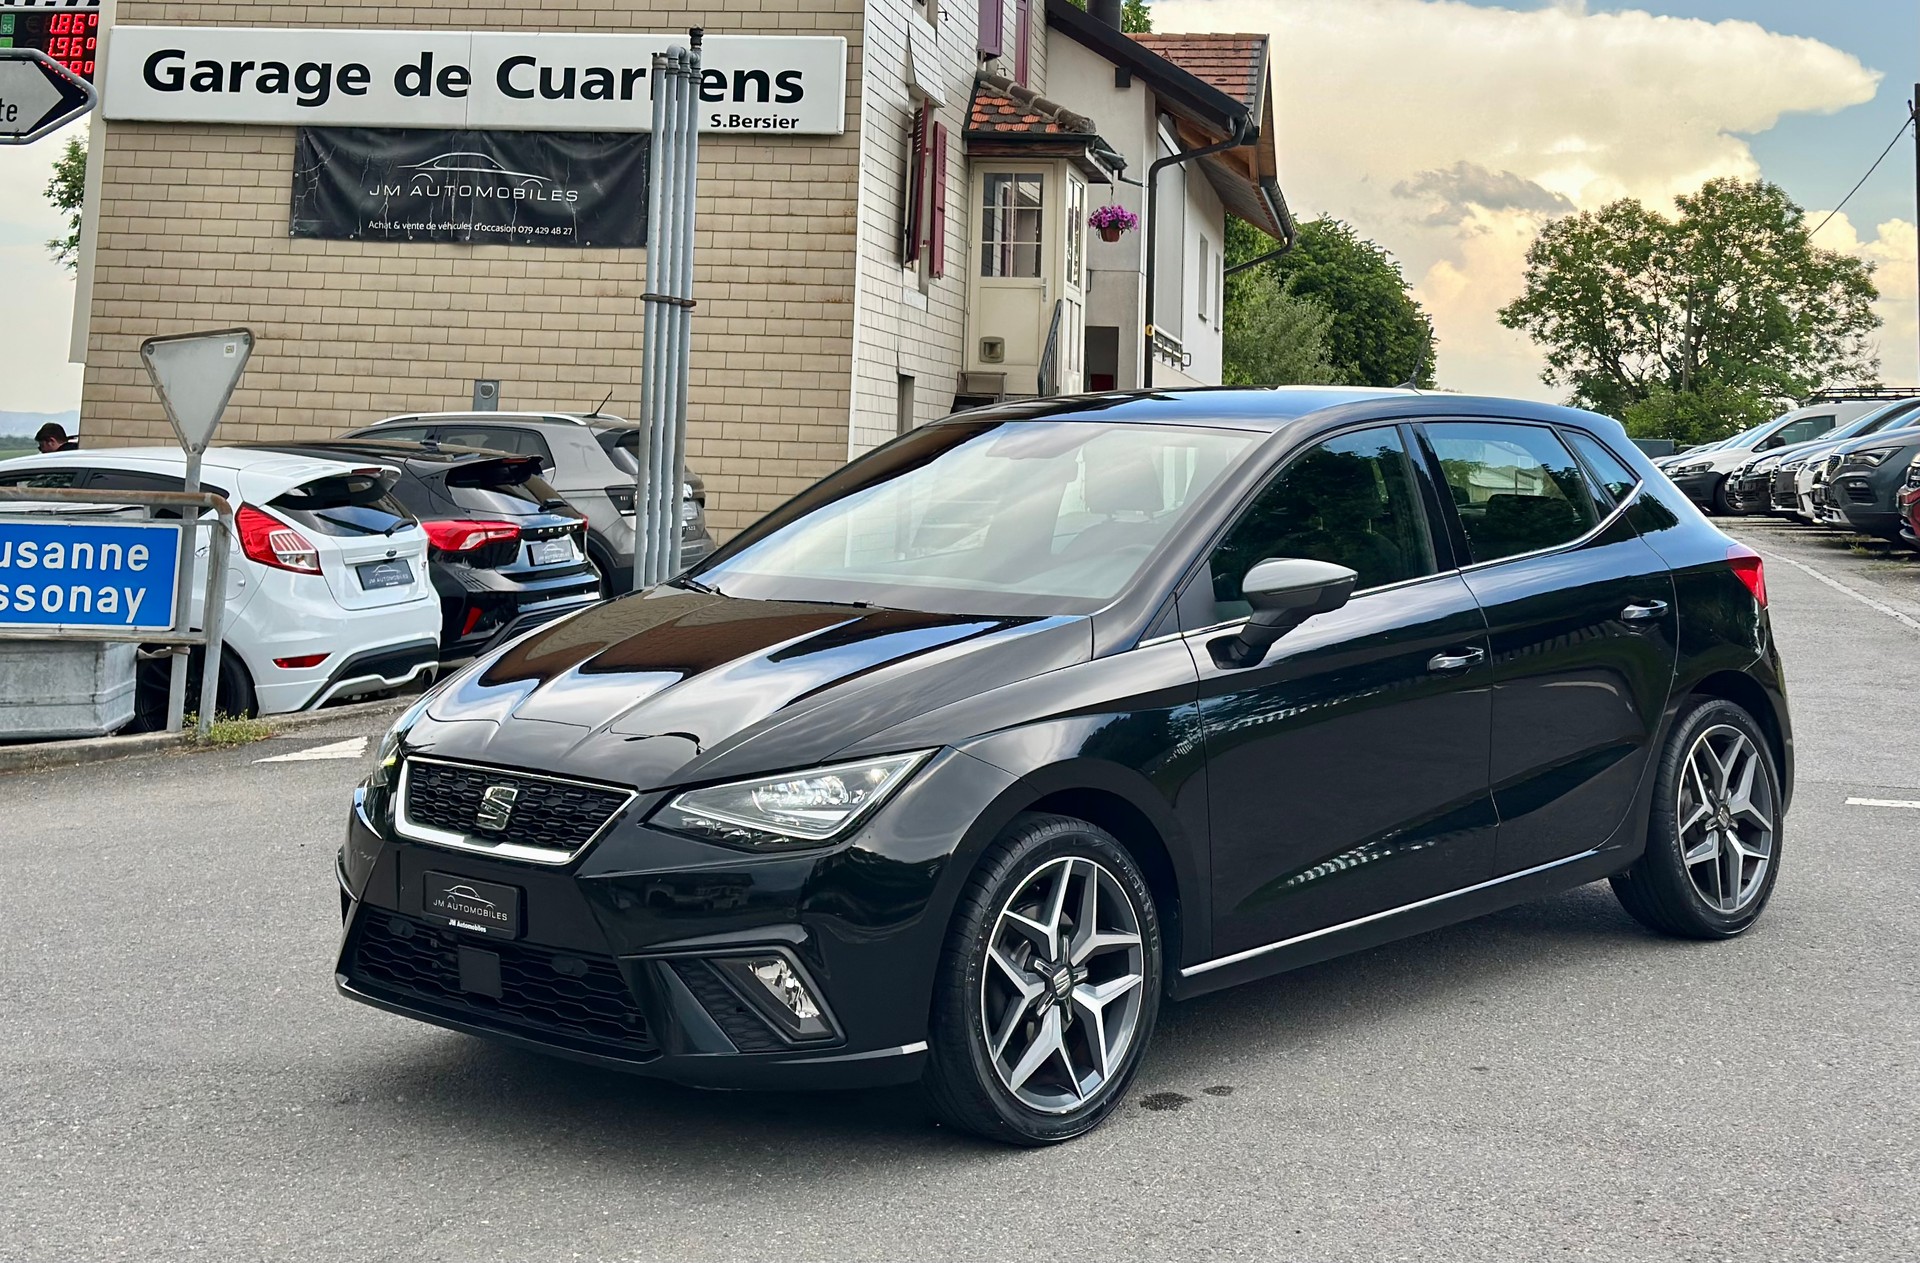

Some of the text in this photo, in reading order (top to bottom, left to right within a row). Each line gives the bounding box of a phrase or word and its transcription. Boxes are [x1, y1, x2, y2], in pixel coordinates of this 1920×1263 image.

[143, 49, 804, 107] Garage de Cuarens
[710, 113, 800, 130] S.Bersier
[369, 185, 579, 202] JM AUTOMOBILES
[368, 220, 573, 236] Achat & vente de véhicules d'occasion 079 429 48 27
[433, 899, 508, 921] JM AUTOMOBILES
[456, 920, 487, 933] Automobiles
